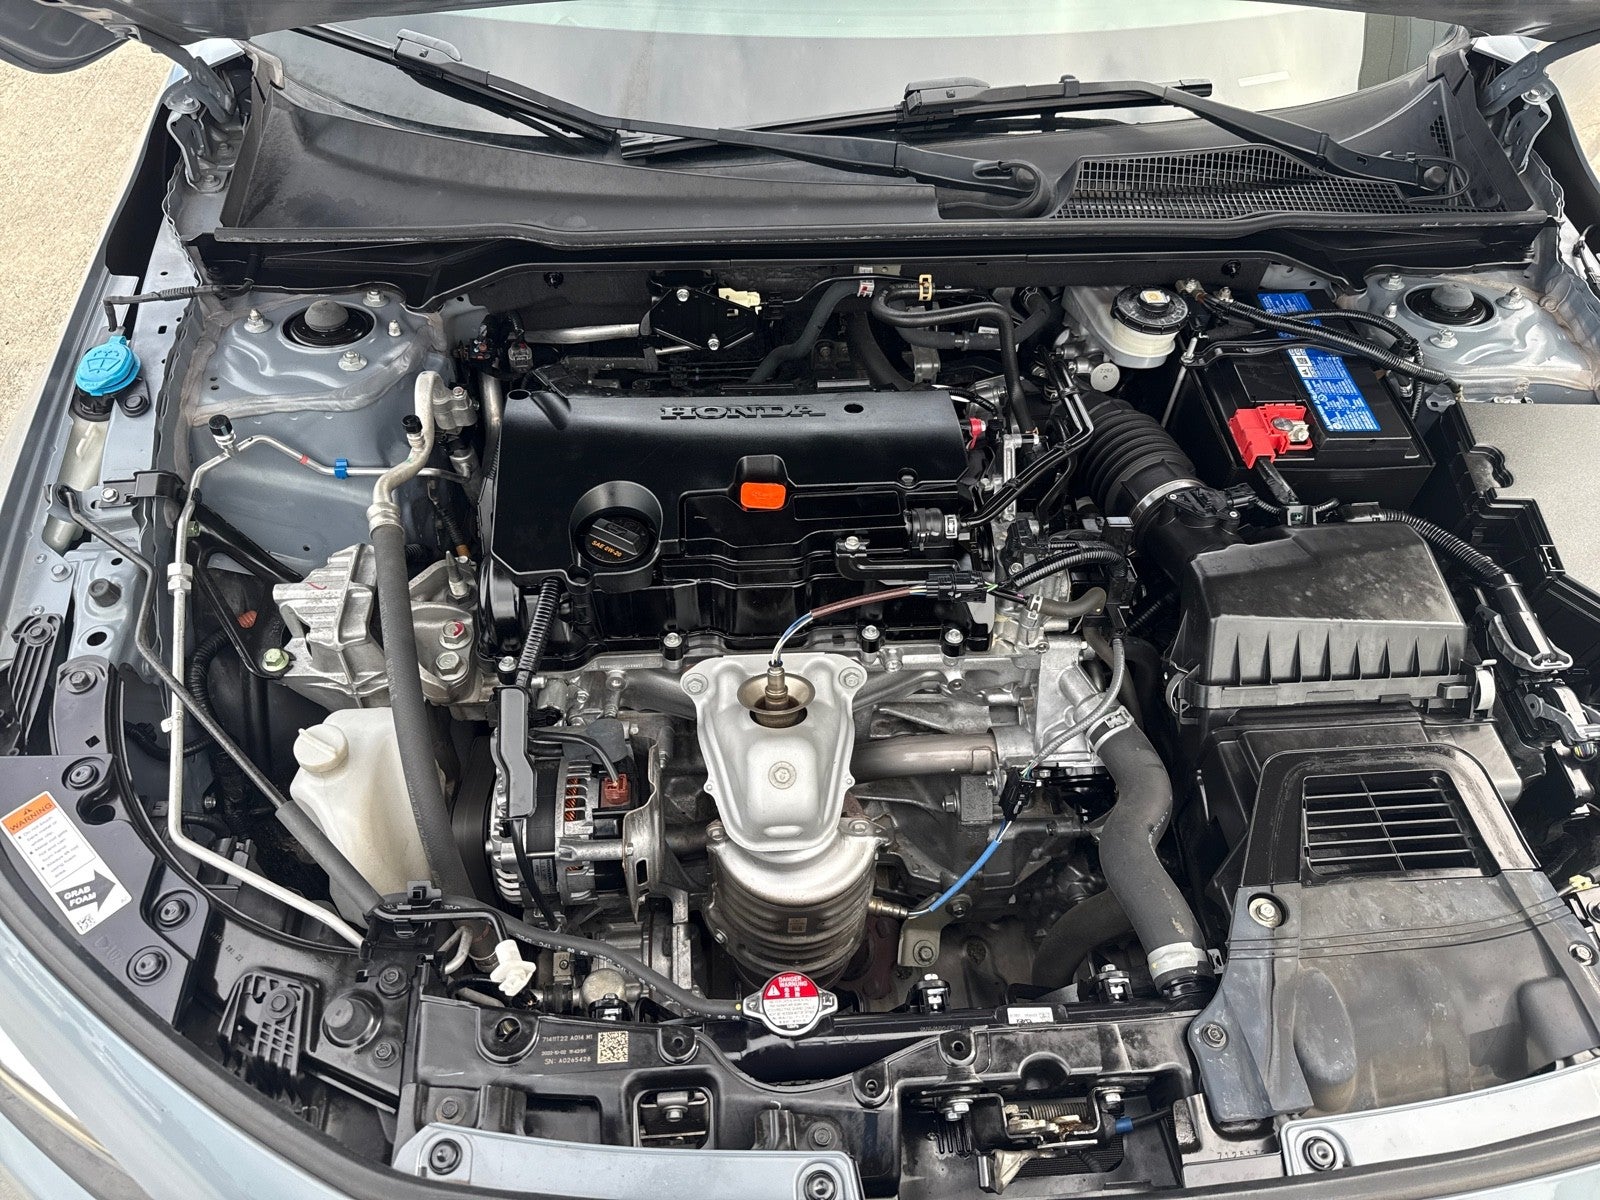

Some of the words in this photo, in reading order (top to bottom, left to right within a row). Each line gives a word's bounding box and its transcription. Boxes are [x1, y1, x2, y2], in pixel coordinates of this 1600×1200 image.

[660, 404, 826, 420] HONDA
[592, 540, 605, 550] SAE
[604, 546, 622, 558] 0W-20
[10, 802, 53, 831] WARNING
[64, 886, 91, 900] GRAB
[70, 892, 96, 907] FOAM
